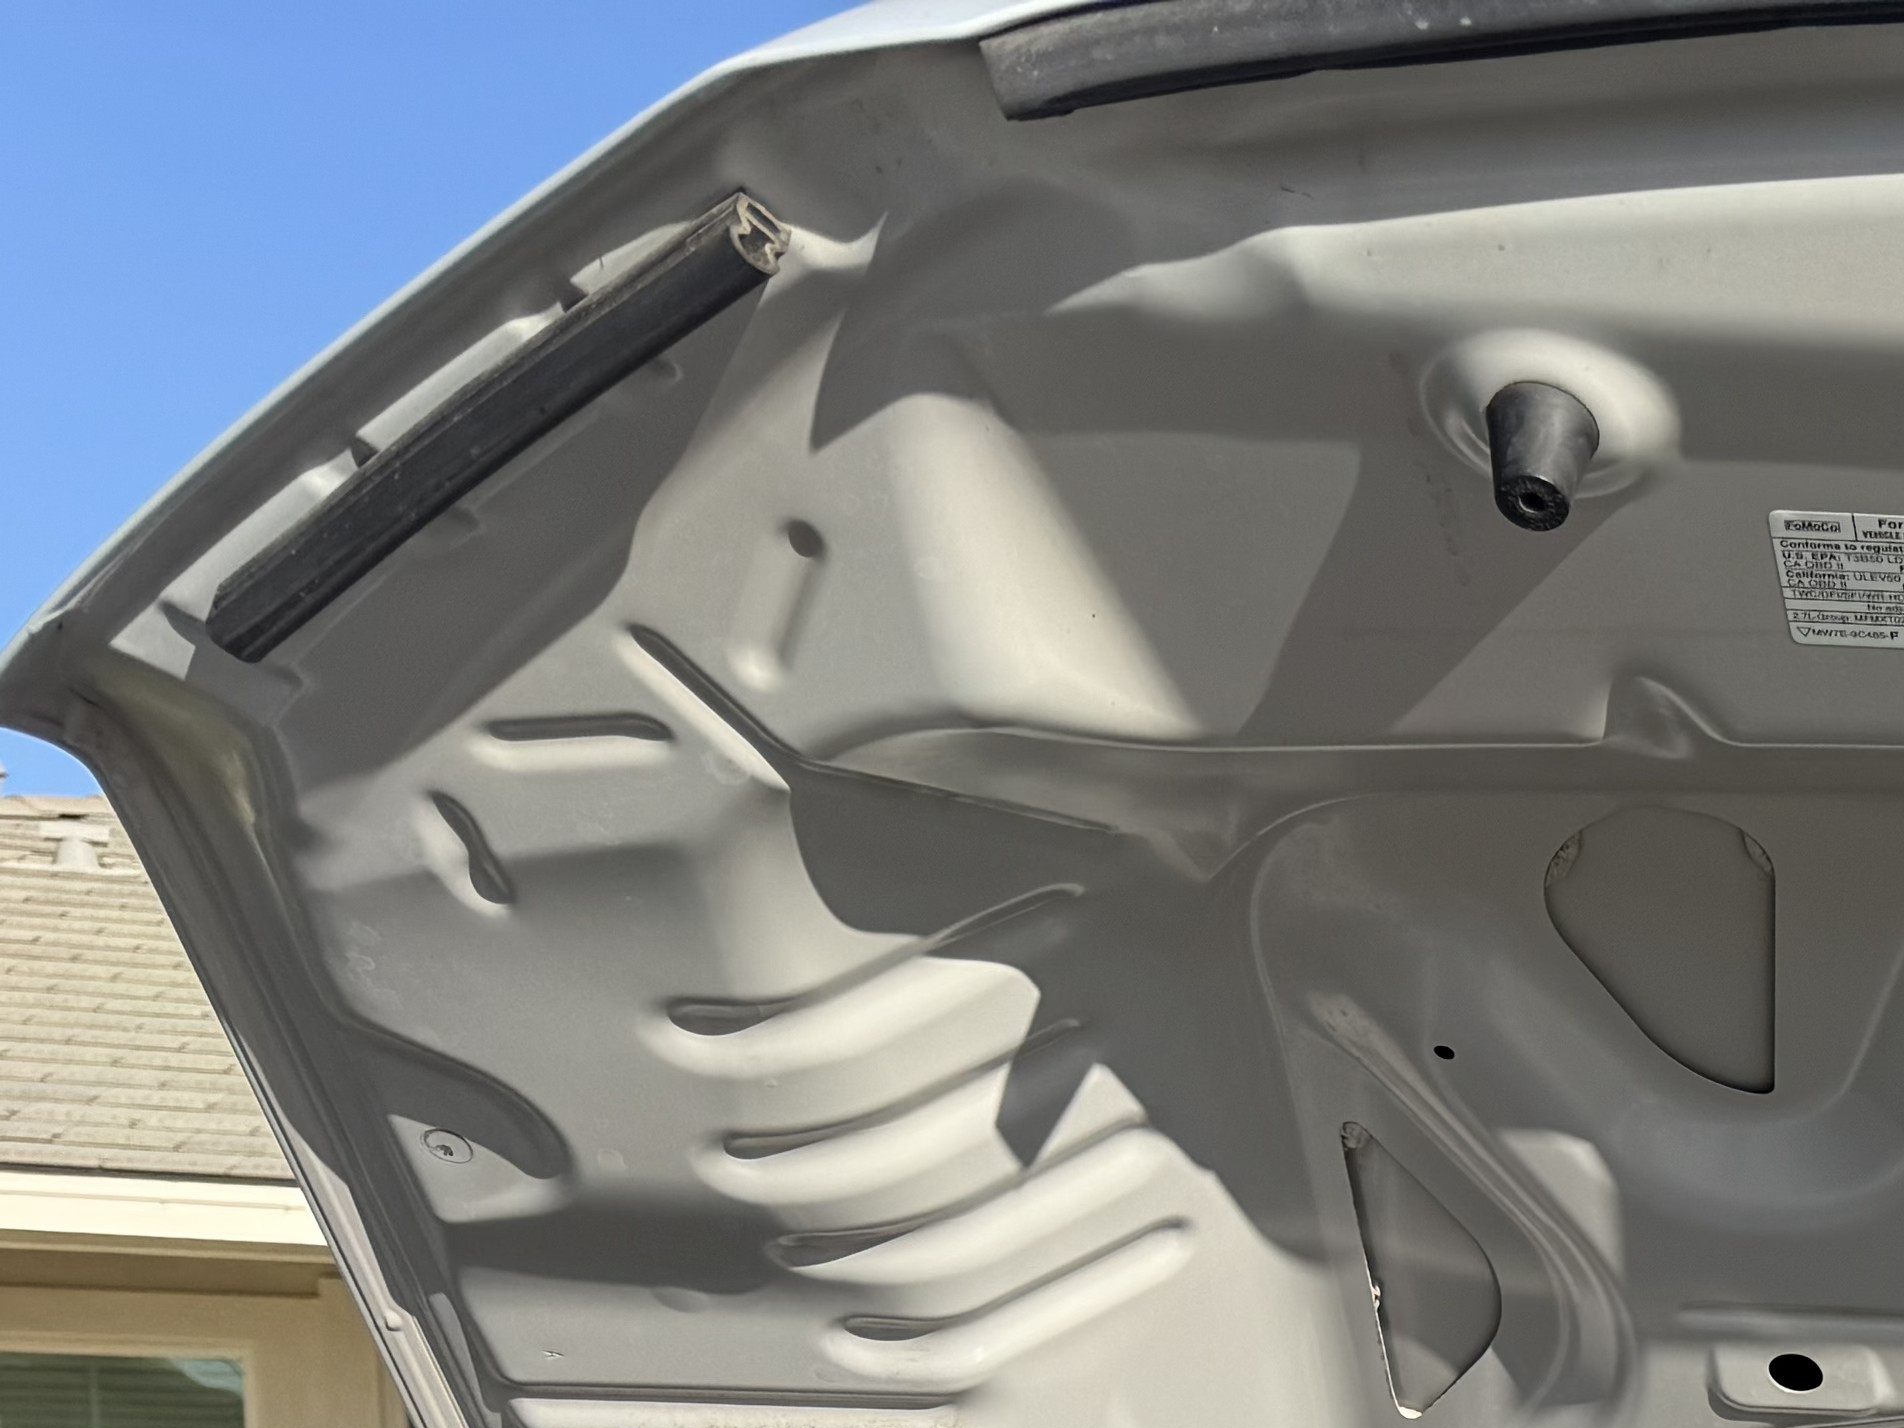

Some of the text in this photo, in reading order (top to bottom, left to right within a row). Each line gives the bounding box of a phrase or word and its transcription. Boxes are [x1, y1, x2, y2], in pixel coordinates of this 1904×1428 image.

[1784, 520, 1840, 532] FoMoCo
[1778, 539, 1840, 551] Conforms
[1842, 542, 1857, 551] to
